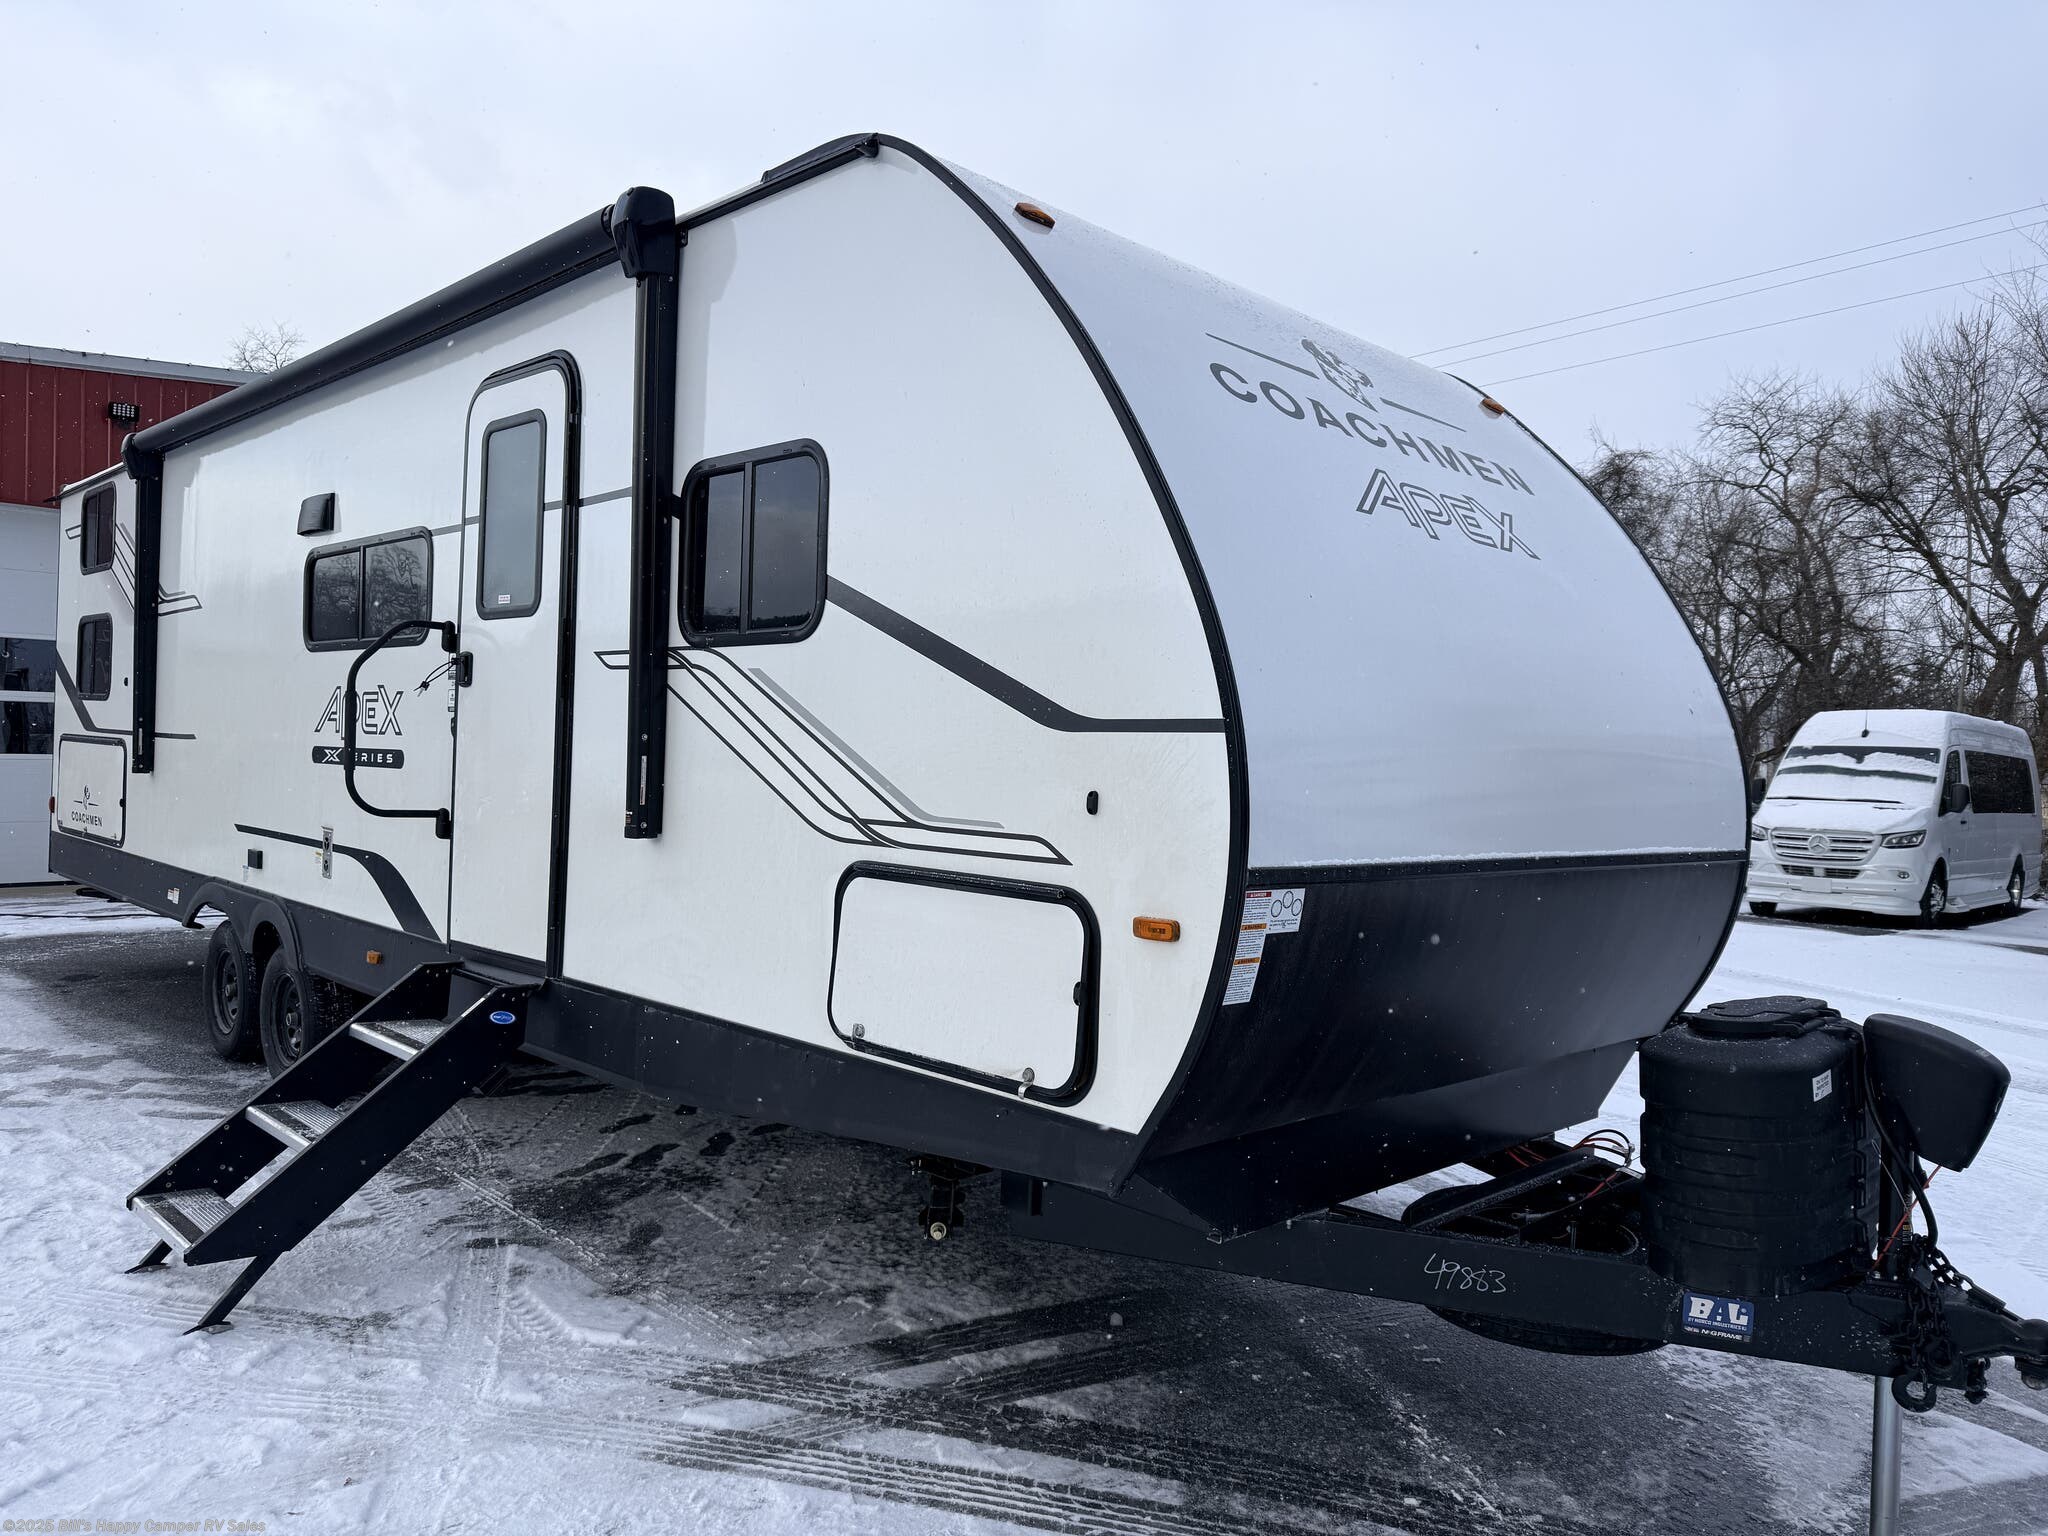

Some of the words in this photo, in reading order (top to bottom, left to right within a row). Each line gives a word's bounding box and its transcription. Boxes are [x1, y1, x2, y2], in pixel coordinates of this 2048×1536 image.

[1209, 362, 1535, 496] COACHMEN
[1356, 468, 1541, 560] APEX
[355, 752, 394, 763] RIES
[71, 811, 102, 827] COACHMEN
[1423, 1252, 1507, 1293] 49883
